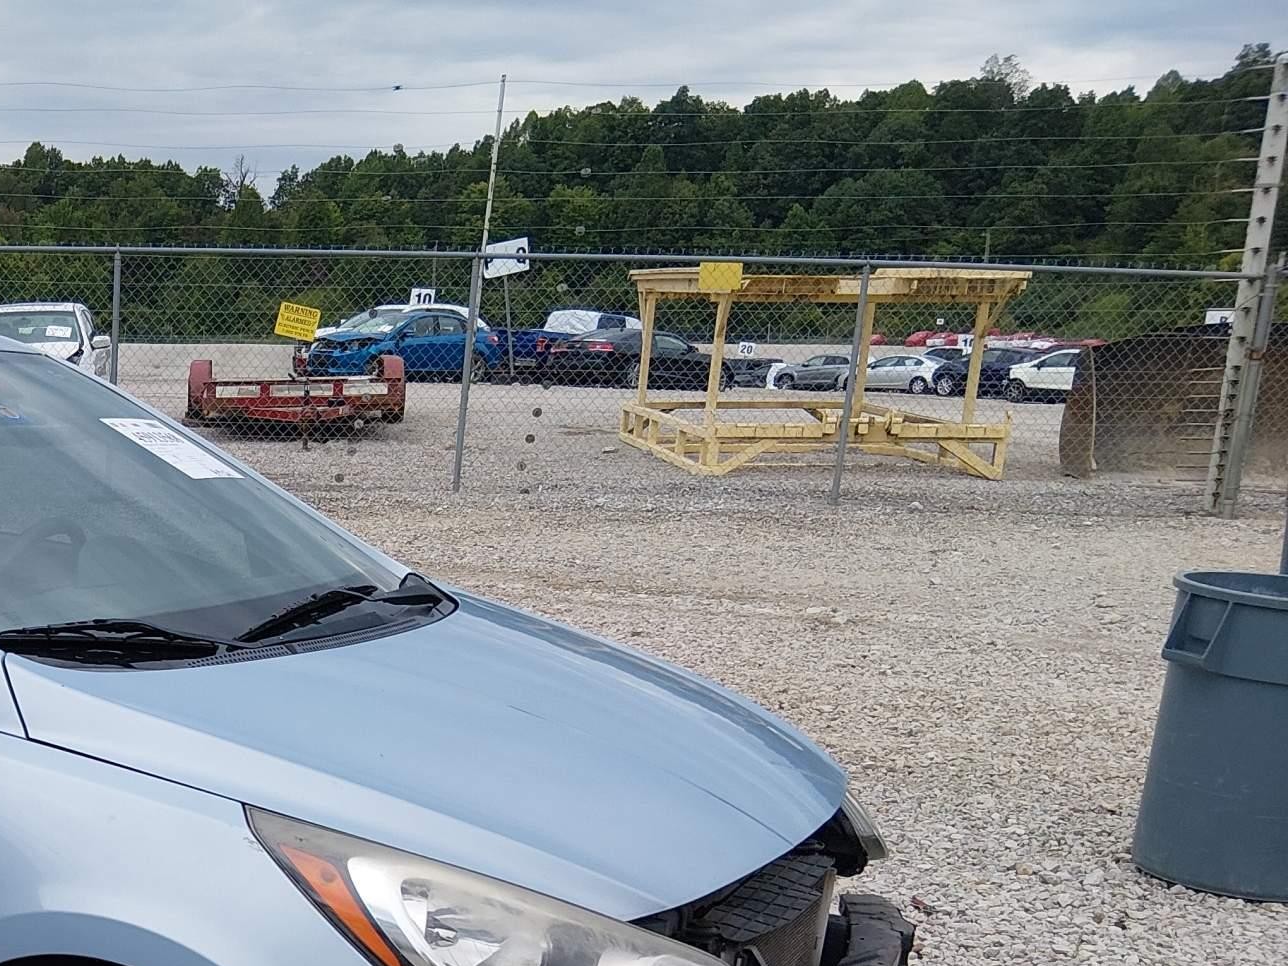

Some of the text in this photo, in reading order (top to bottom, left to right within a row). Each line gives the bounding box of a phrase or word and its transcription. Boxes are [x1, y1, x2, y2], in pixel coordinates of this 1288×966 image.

[415, 292, 432, 305] 10
[284, 304, 318, 318] WARNING
[740, 344, 753, 354] 20
